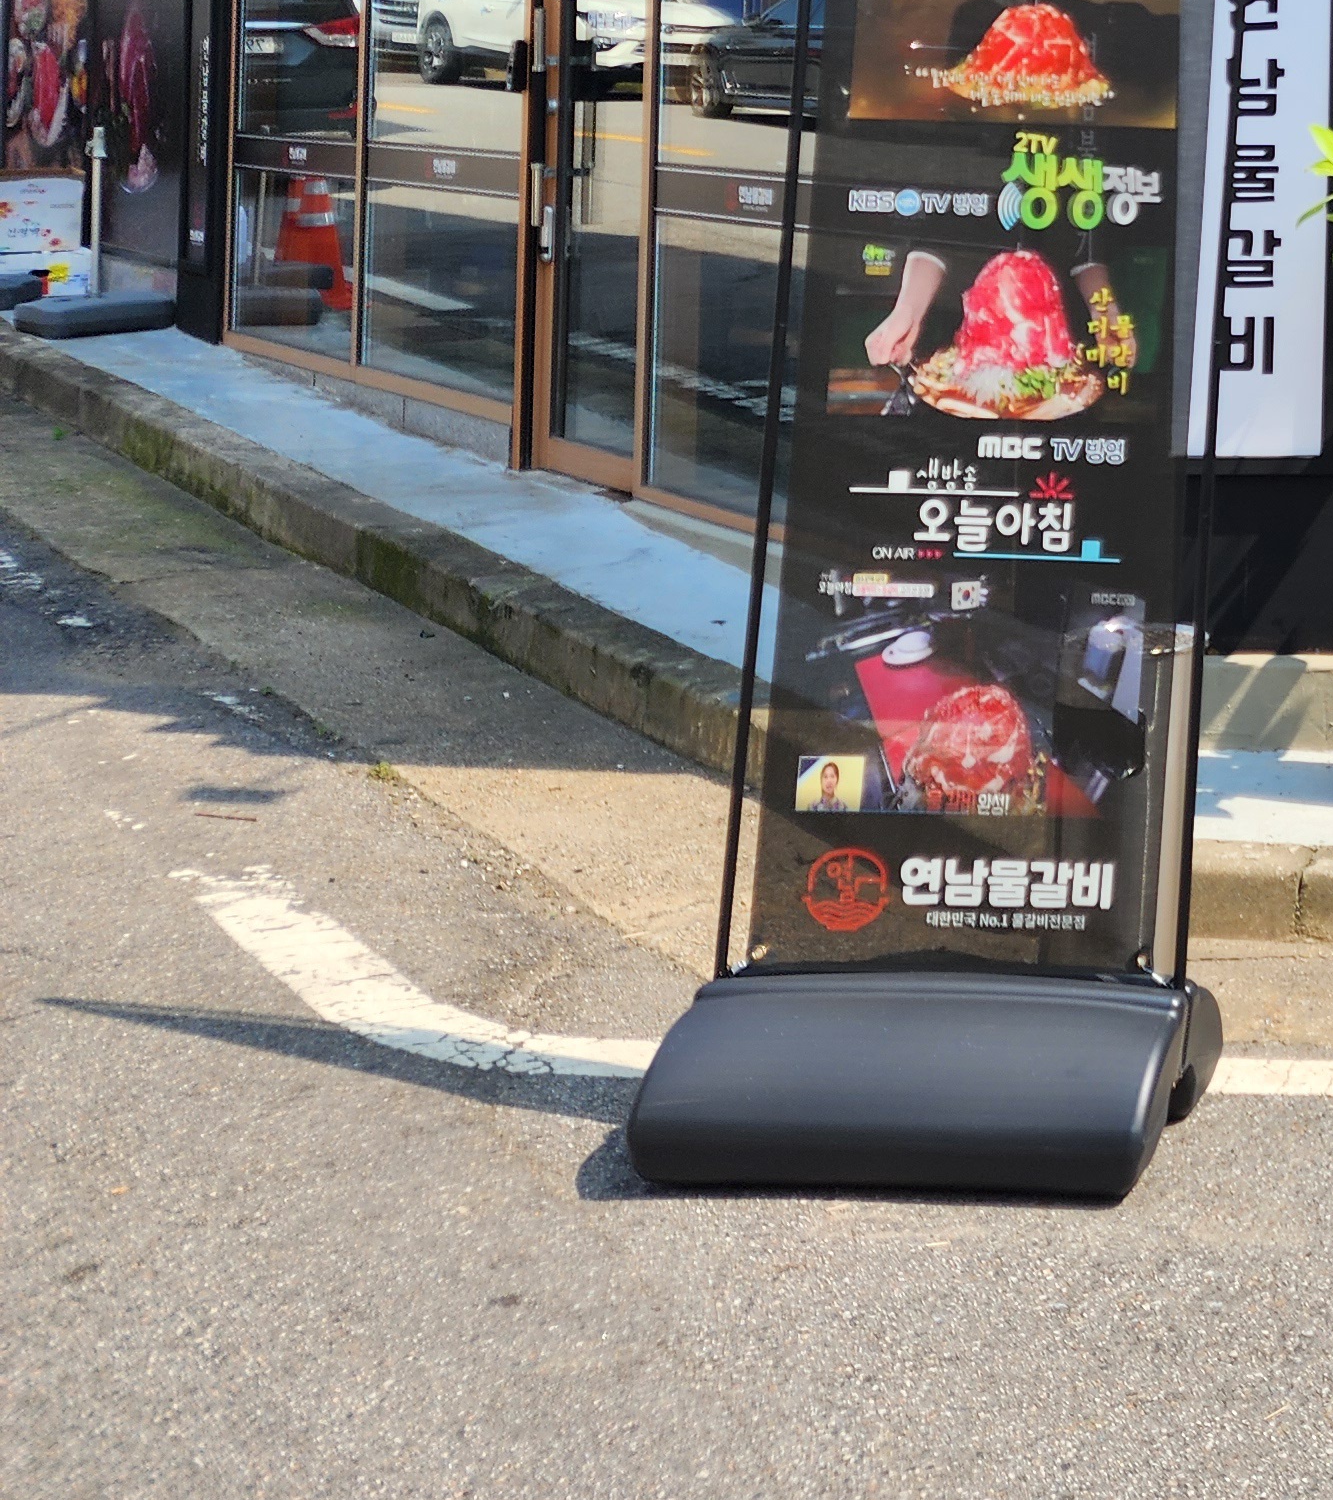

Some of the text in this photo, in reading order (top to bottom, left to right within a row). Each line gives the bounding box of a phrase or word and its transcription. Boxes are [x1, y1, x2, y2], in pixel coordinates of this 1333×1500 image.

[1013, 131, 1058, 155] 2TV
[848, 190, 988, 217] KBS TV 방영
[1001, 152, 1162, 230] 생생정보
[1086, 287, 1114, 368] 산더미
[1107, 314, 1135, 396] 물갈비
[1050, 438, 1083, 462] TV
[1085, 438, 1127, 465] 방영
[916, 457, 978, 492] 생방송
[913, 499, 1074, 553] 오늘아침
[872, 546, 893, 560] ON
[900, 857, 1114, 910] 연남물갈비
[926, 911, 1087, 931] 대한민국 No.1 물갈비전문점
